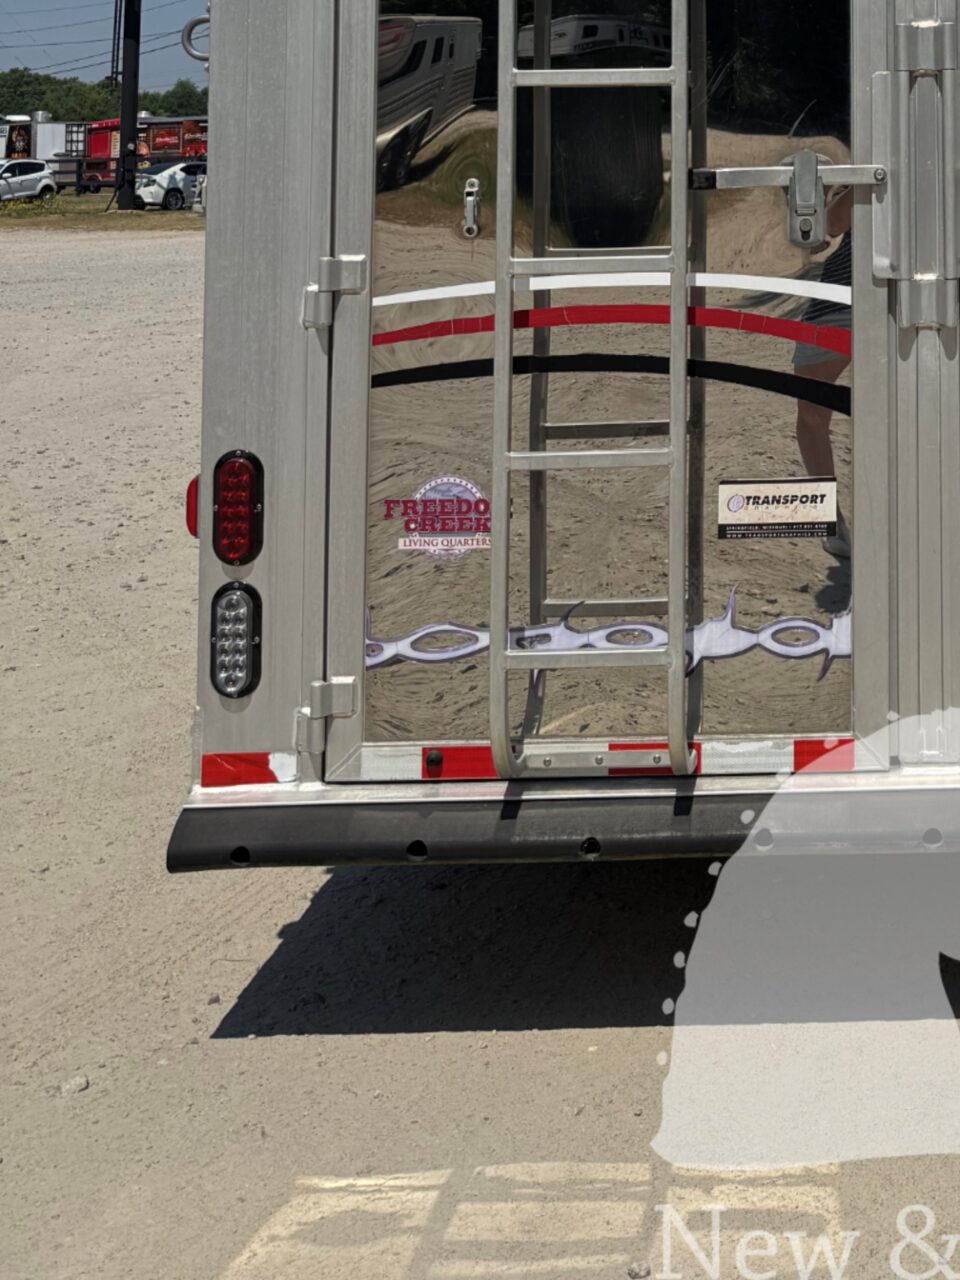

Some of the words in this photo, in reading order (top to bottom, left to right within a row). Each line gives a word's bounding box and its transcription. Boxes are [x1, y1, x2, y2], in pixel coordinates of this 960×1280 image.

[745, 494, 827, 506] TRANSPORT
[384, 498, 492, 519] FREEDO
[404, 517, 492, 533] CREEK
[403, 538, 439, 548] LIVING
